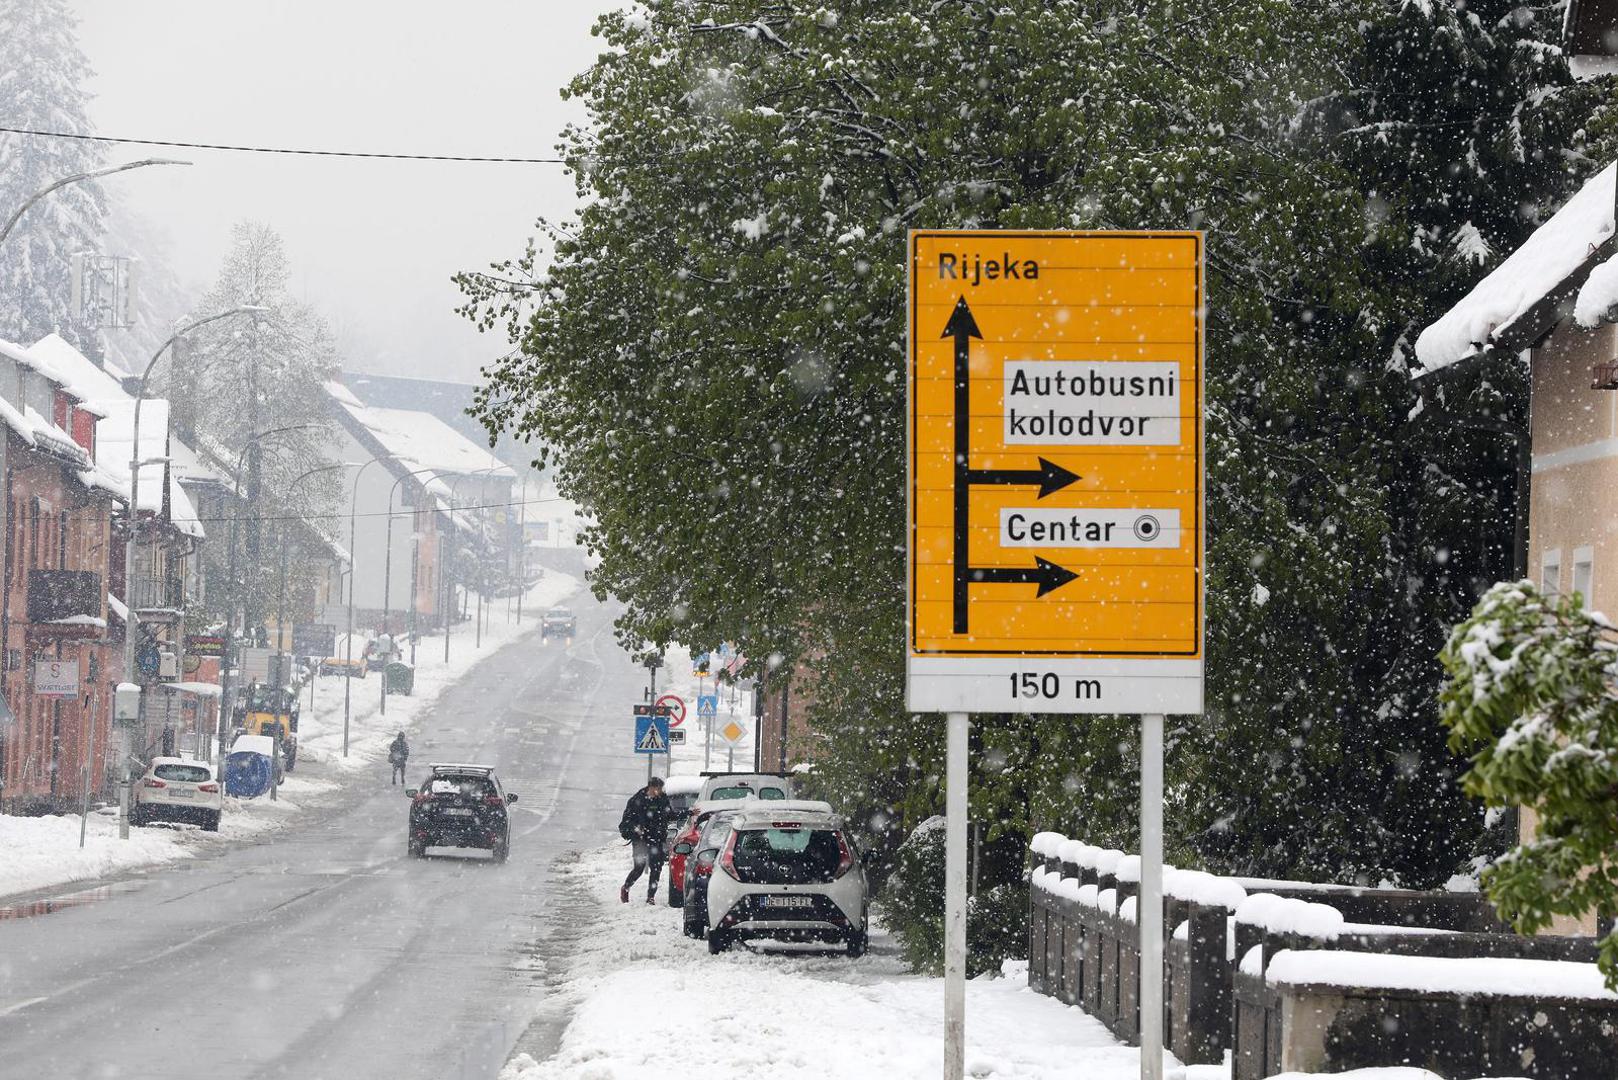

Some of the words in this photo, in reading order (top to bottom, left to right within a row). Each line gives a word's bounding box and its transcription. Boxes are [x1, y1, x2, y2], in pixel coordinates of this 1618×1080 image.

[939, 252, 1039, 287] Rijeka
[1010, 369, 1174, 397] Autobusni
[1010, 408, 1151, 437] kolodvor
[1008, 513, 1116, 542] Centar
[1010, 672, 1060, 699] 150
[1075, 679, 1102, 699] m
